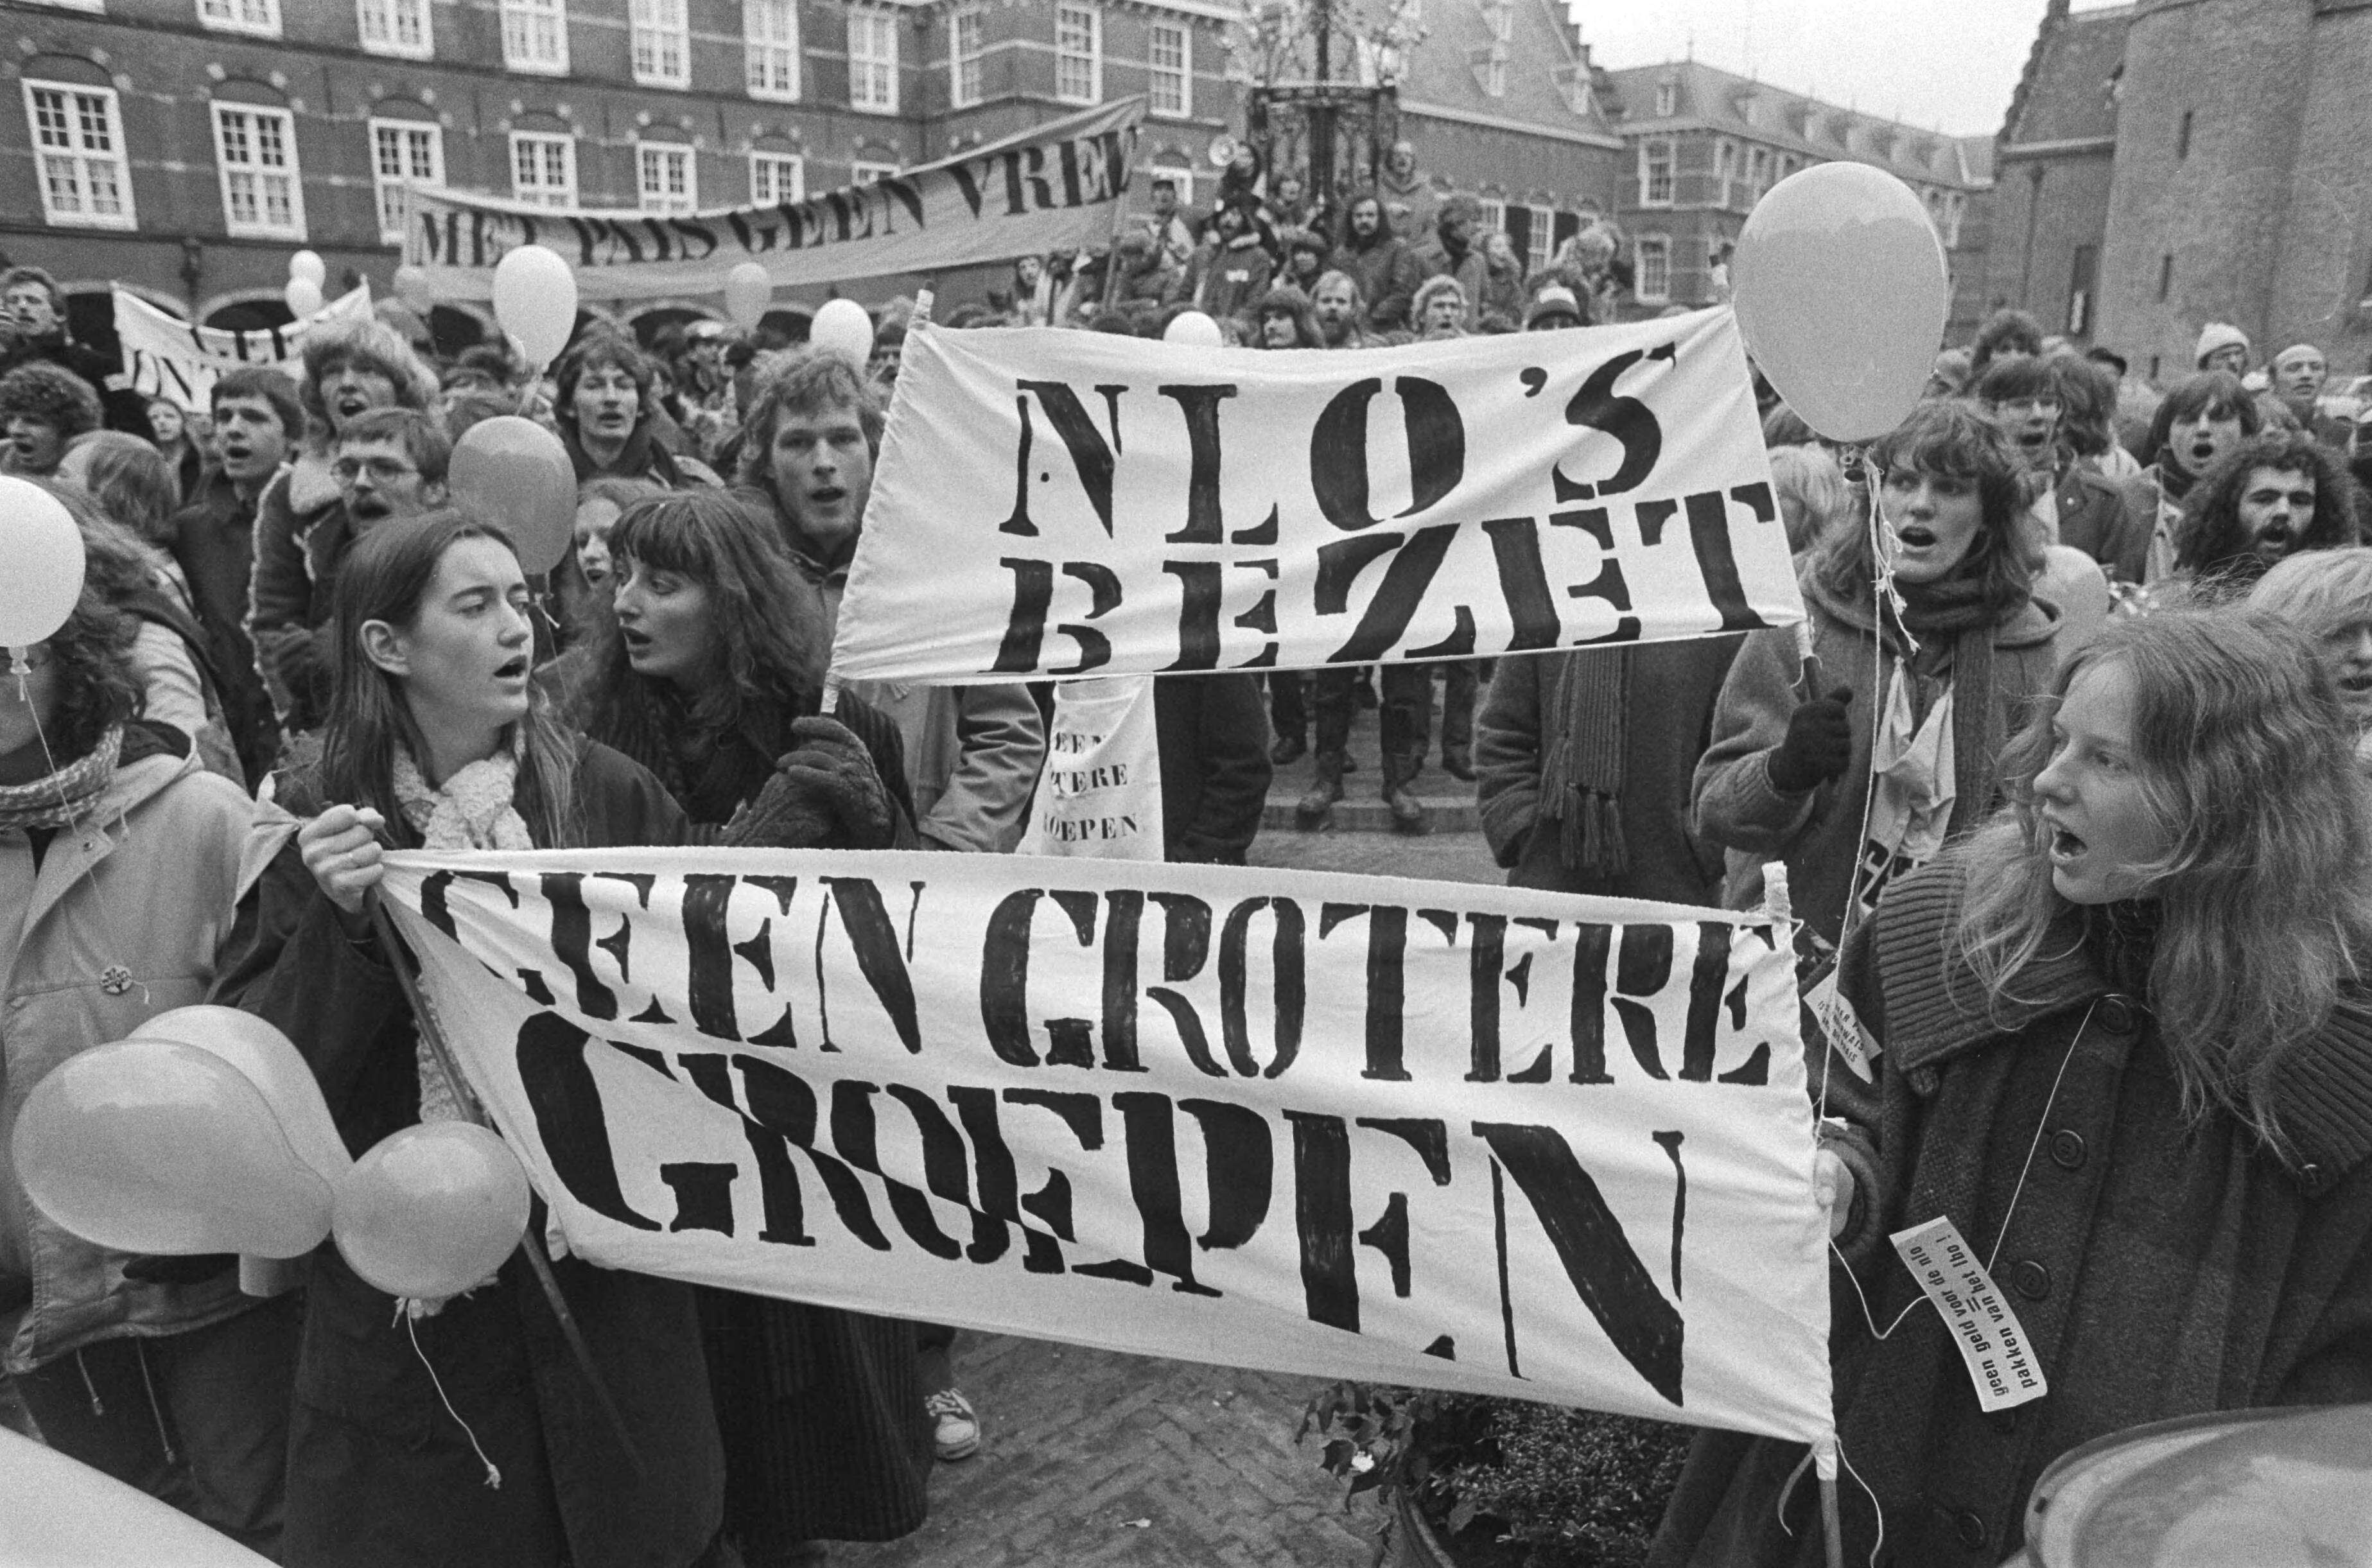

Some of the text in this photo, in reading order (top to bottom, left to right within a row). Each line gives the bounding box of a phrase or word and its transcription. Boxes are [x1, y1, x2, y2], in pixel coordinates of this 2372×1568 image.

[727, 177, 923, 253] GEEN
[999, 342, 1676, 545] NLO'S
[977, 482, 1778, 675] BEZET
[421, 869, 1775, 1086] GEEN GROTERE
[516, 1011, 1685, 1407] GROEPEN
[1946, 1244, 1969, 1268] lbo
[1909, 1245, 2009, 1397] geen geld voor de nlo
[1961, 1269, 1987, 1295] het
[1981, 1294, 2005, 1323] van
[1998, 1326, 2038, 1389] pakken
